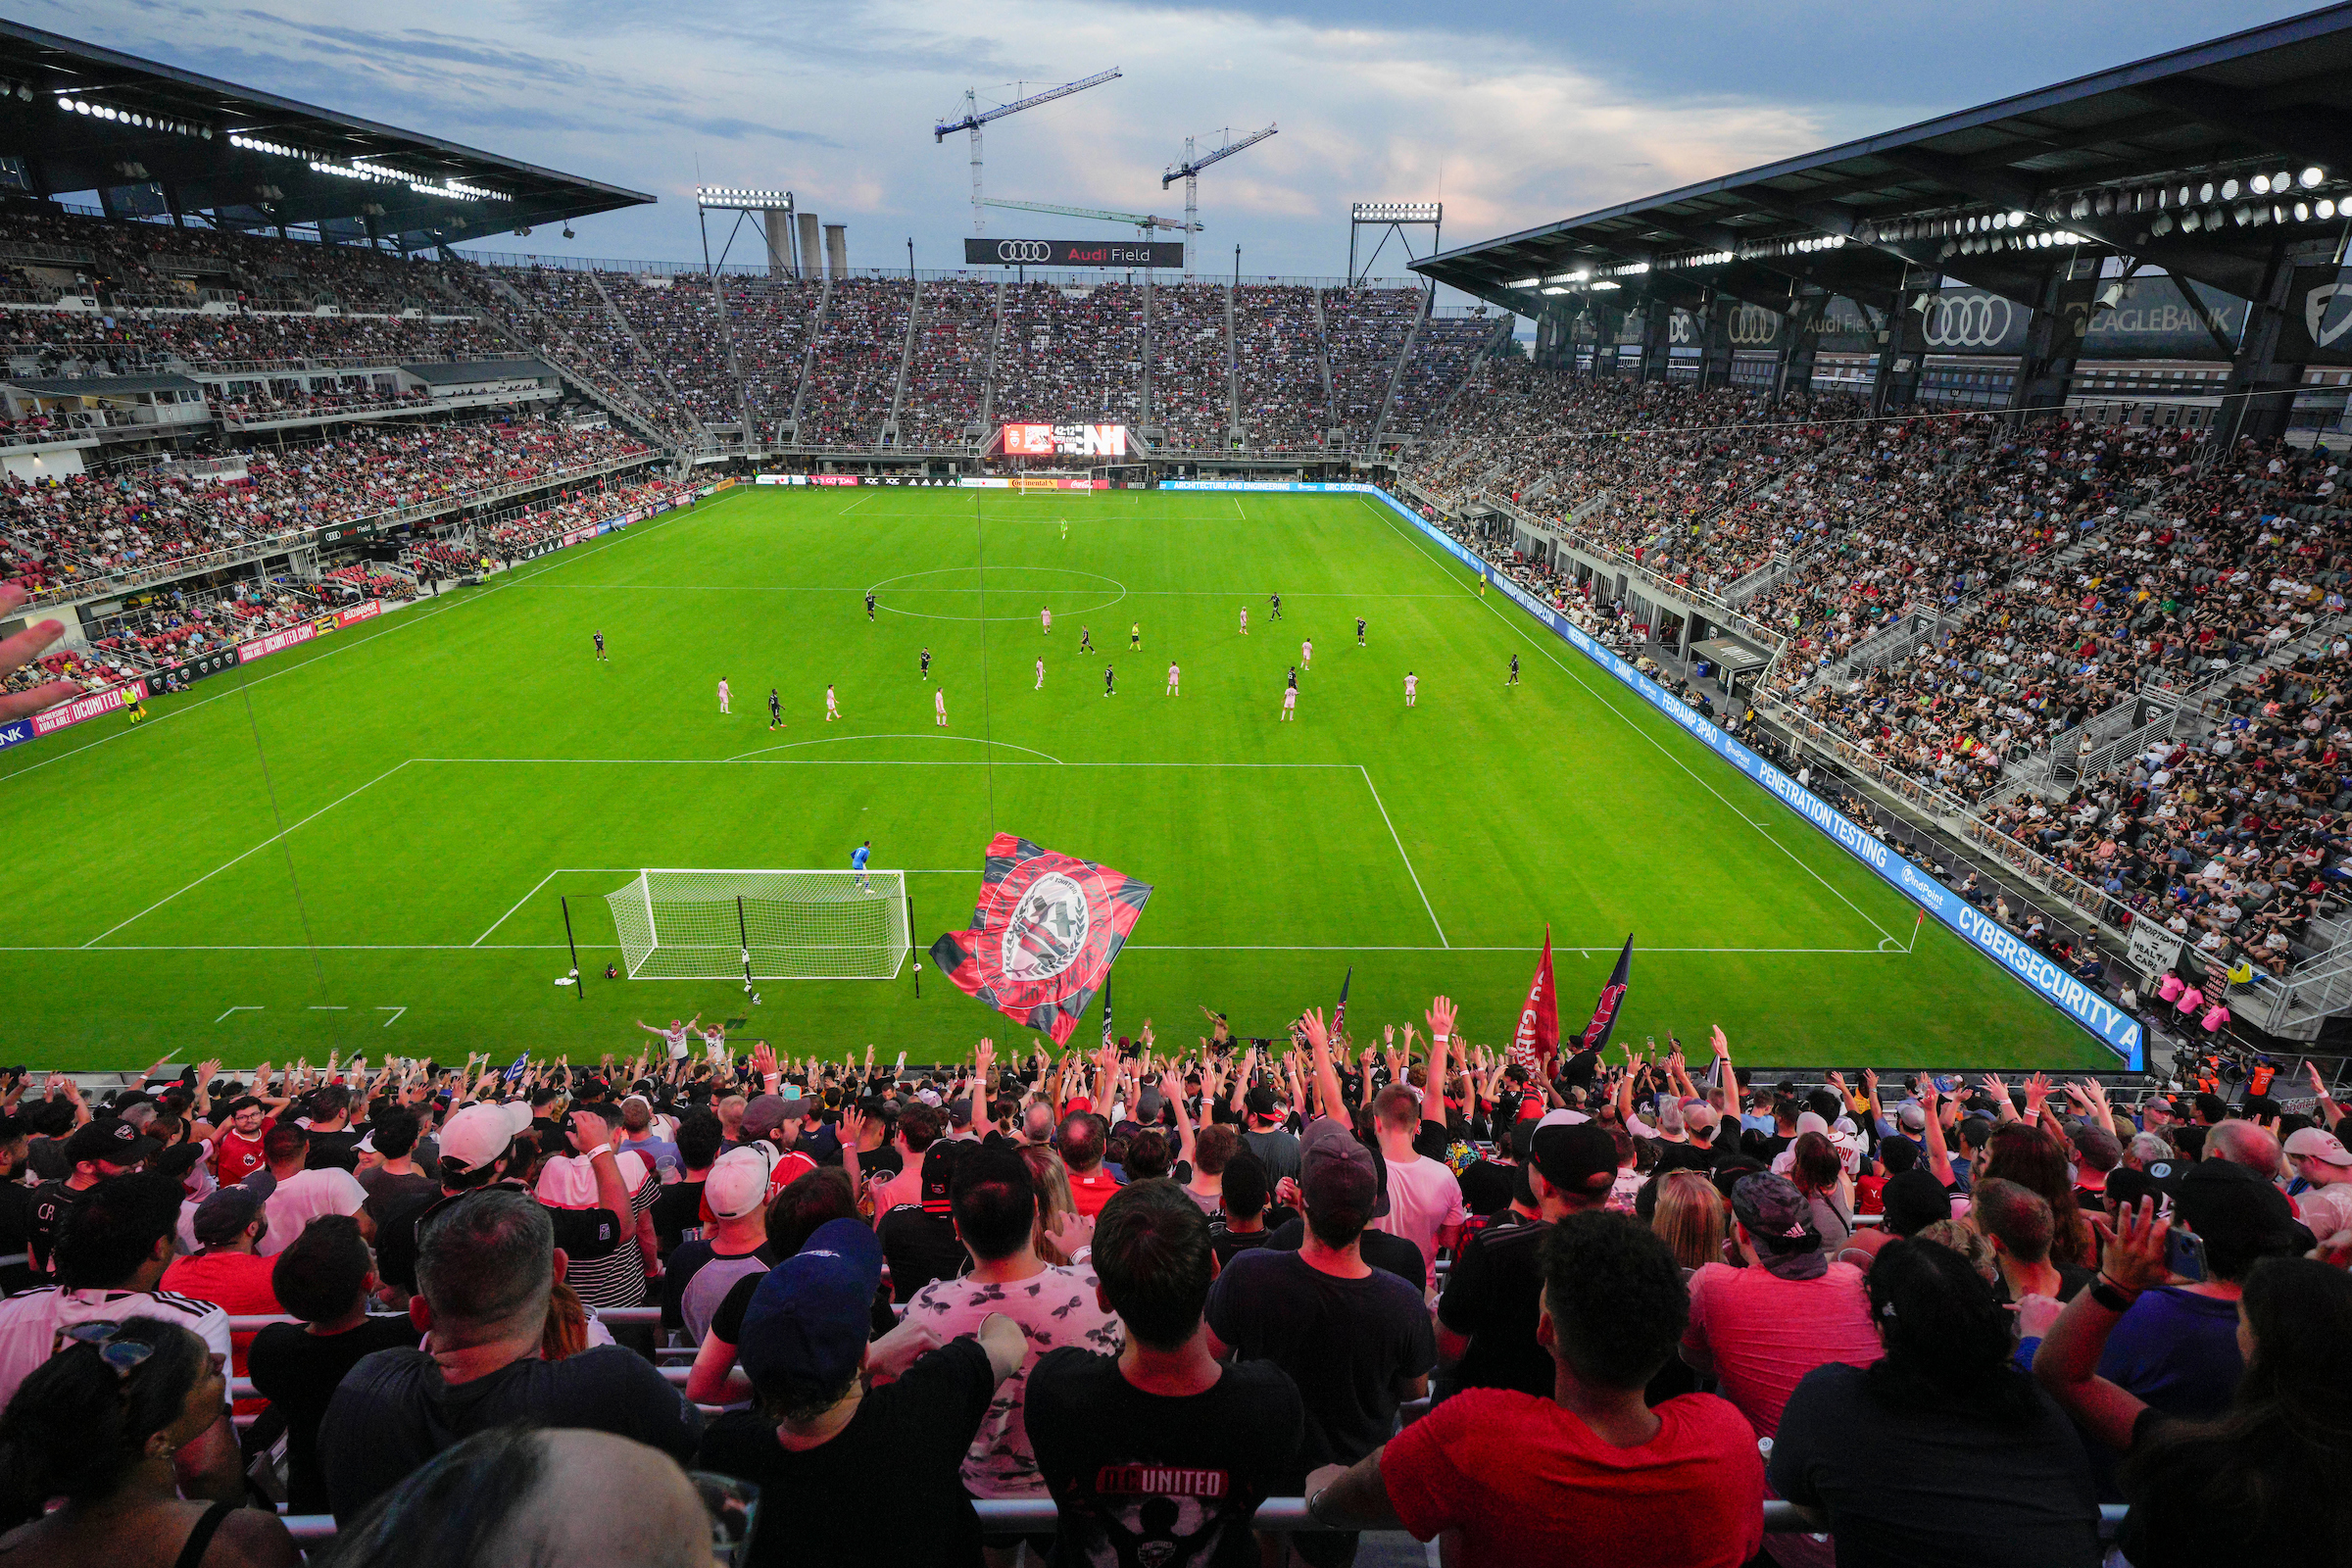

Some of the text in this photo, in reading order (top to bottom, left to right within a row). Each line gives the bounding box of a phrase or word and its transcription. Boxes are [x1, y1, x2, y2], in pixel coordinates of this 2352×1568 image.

[1068, 248, 1150, 261] Audi Field
[1669, 315, 1690, 343] DC
[1803, 315, 1839, 332] Audi
[1054, 425, 1075, 436] 42:12
[1174, 481, 1225, 490] ARCHITECTURE
[1227, 481, 1243, 490] AND
[357, 524, 370, 533] Field
[265, 624, 314, 652] DCUNITED.COM
[243, 646, 265, 662] AVAILABLE
[1614, 659, 1633, 682] CMMC
[73, 683, 143, 720] DCUNITED.M
[38, 713, 72, 732] AVAILABLE
[1662, 692, 1717, 744] FEDRAMP 3PAO
[0, 726, 24, 746] NK
[1759, 762, 1886, 867] PENETRATION TESTING
[1902, 864, 1943, 906] MindPoint
[2133, 942, 2167, 964] HEALTH
[2134, 955, 2157, 971] CARE
[1959, 906, 2122, 1035] CYBERSECURITY
[1142, 1470, 1220, 1495] UNITED
